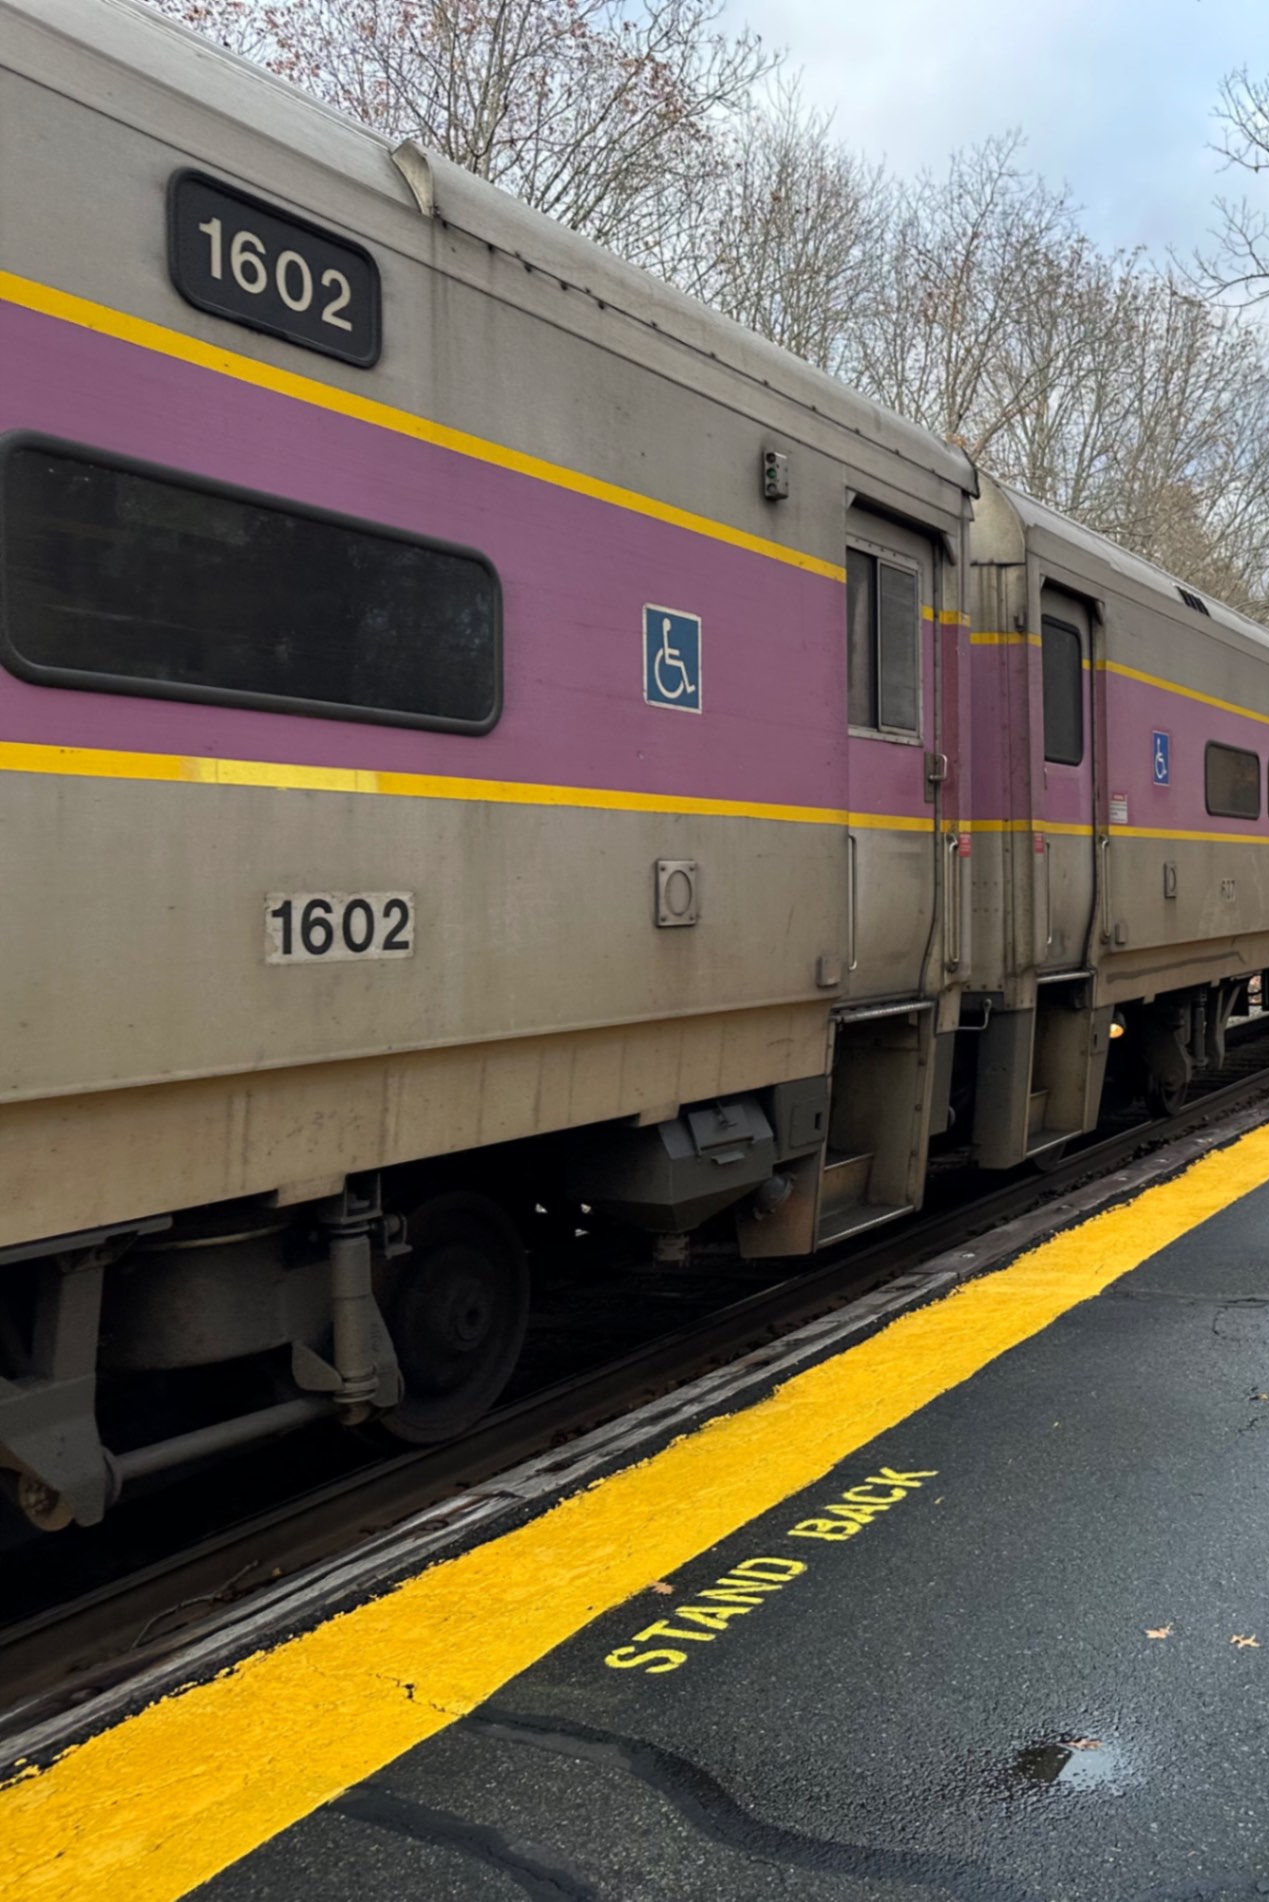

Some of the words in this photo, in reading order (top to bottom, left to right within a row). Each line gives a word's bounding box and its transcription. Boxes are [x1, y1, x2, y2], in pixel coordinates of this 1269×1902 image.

[199, 217, 353, 332] 1602
[271, 898, 410, 956] 1602
[604, 1556, 808, 1674] STAND
[787, 1467, 939, 1541] BACK
